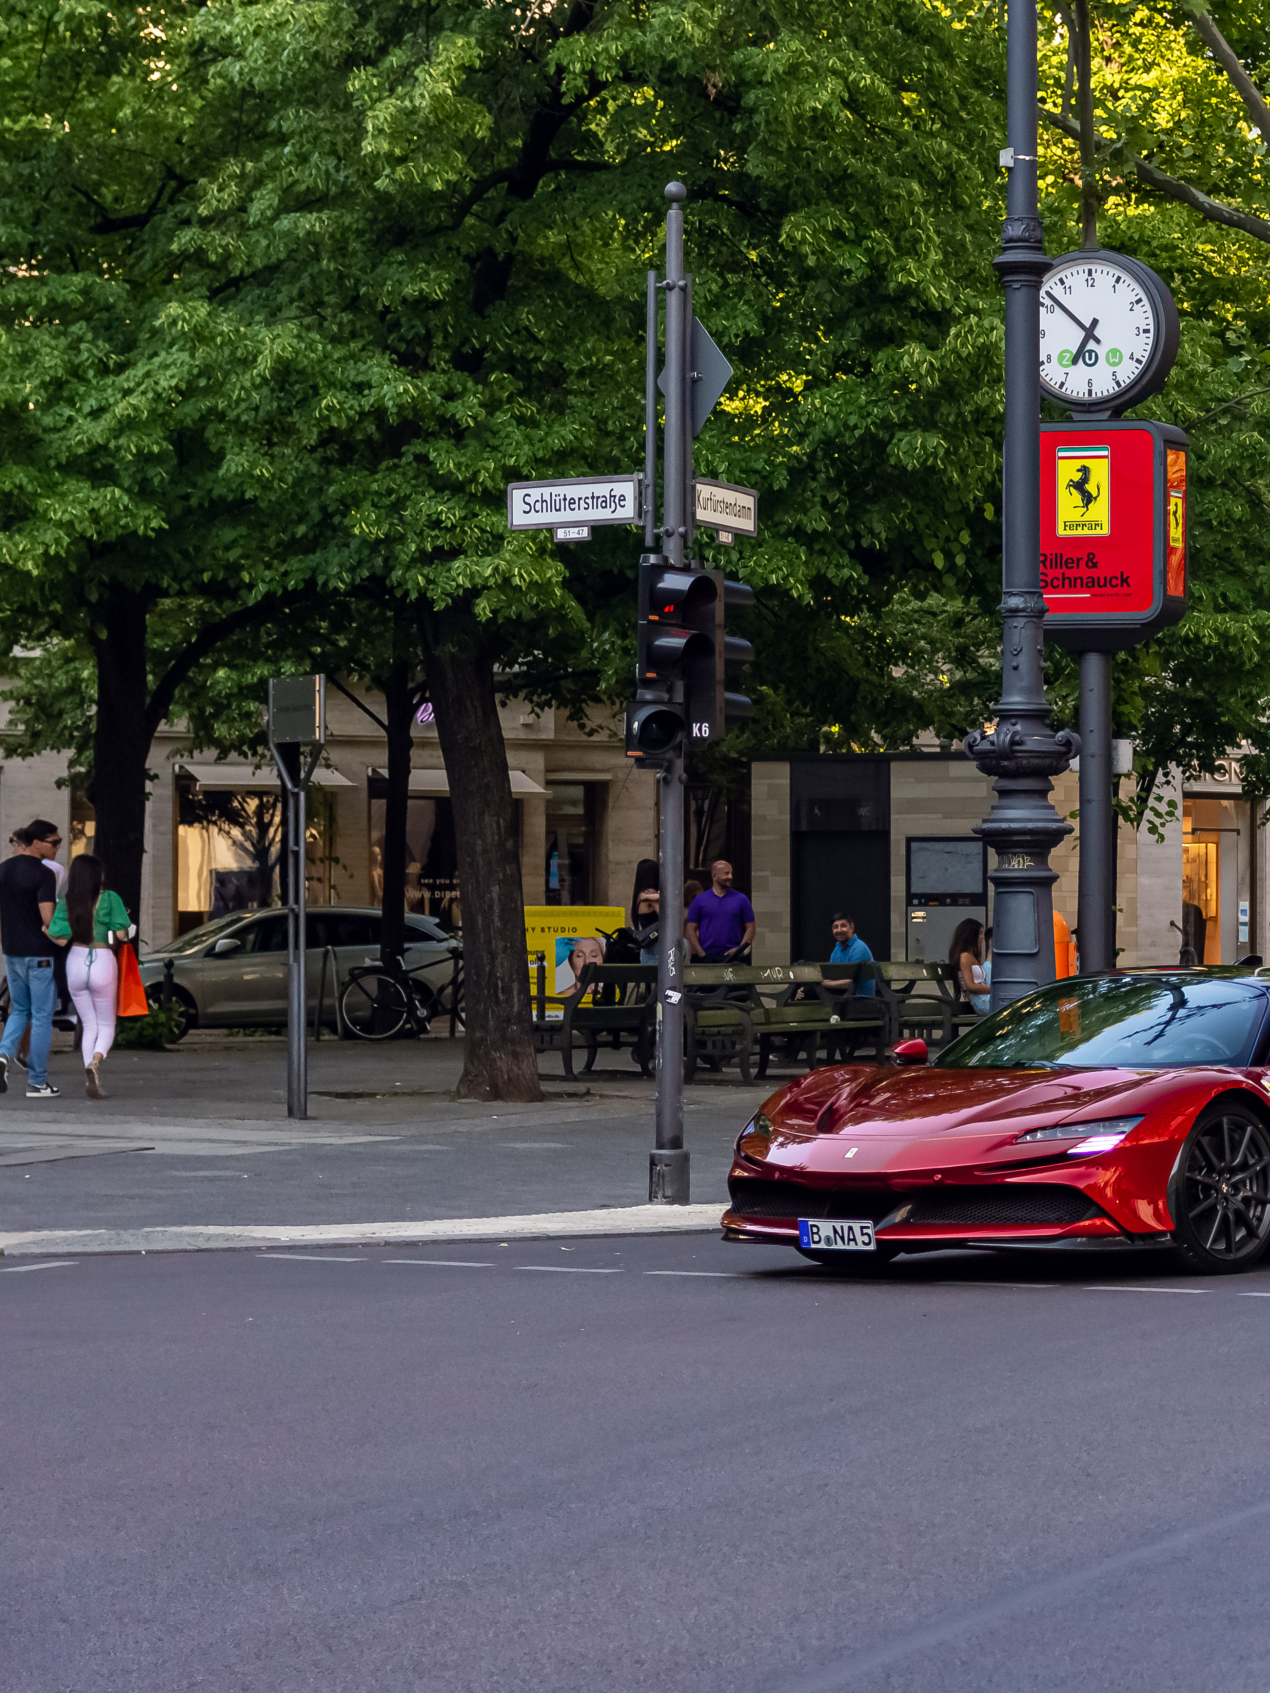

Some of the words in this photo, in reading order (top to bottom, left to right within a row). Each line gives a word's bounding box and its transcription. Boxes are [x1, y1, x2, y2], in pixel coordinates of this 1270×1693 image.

[1085, 278, 1095, 287] 12
[1063, 286, 1072, 295] 11
[1112, 284, 1116, 293] 1
[1045, 304, 1054, 313] 10
[1129, 302, 1134, 311] 2
[1040, 329, 1045, 338] 9
[1135, 327, 1140, 336] 3
[1046, 354, 1051, 363] 8
[1062, 353, 1070, 364] Z
[1085, 352, 1095, 362] U
[1109, 352, 1119, 363] W
[1129, 352, 1134, 361] 4
[1064, 372, 1069, 381] 7
[1112, 371, 1117, 381] 5
[1088, 379, 1093, 388] 6
[522, 488, 626, 514] Schlüterstraße
[697, 489, 752, 520] Kurfürstendamm
[1063, 520, 1103, 531] Ferrari
[1085, 552, 1099, 569] &
[693, 722, 709, 737] K6
[810, 1224, 822, 1244] B
